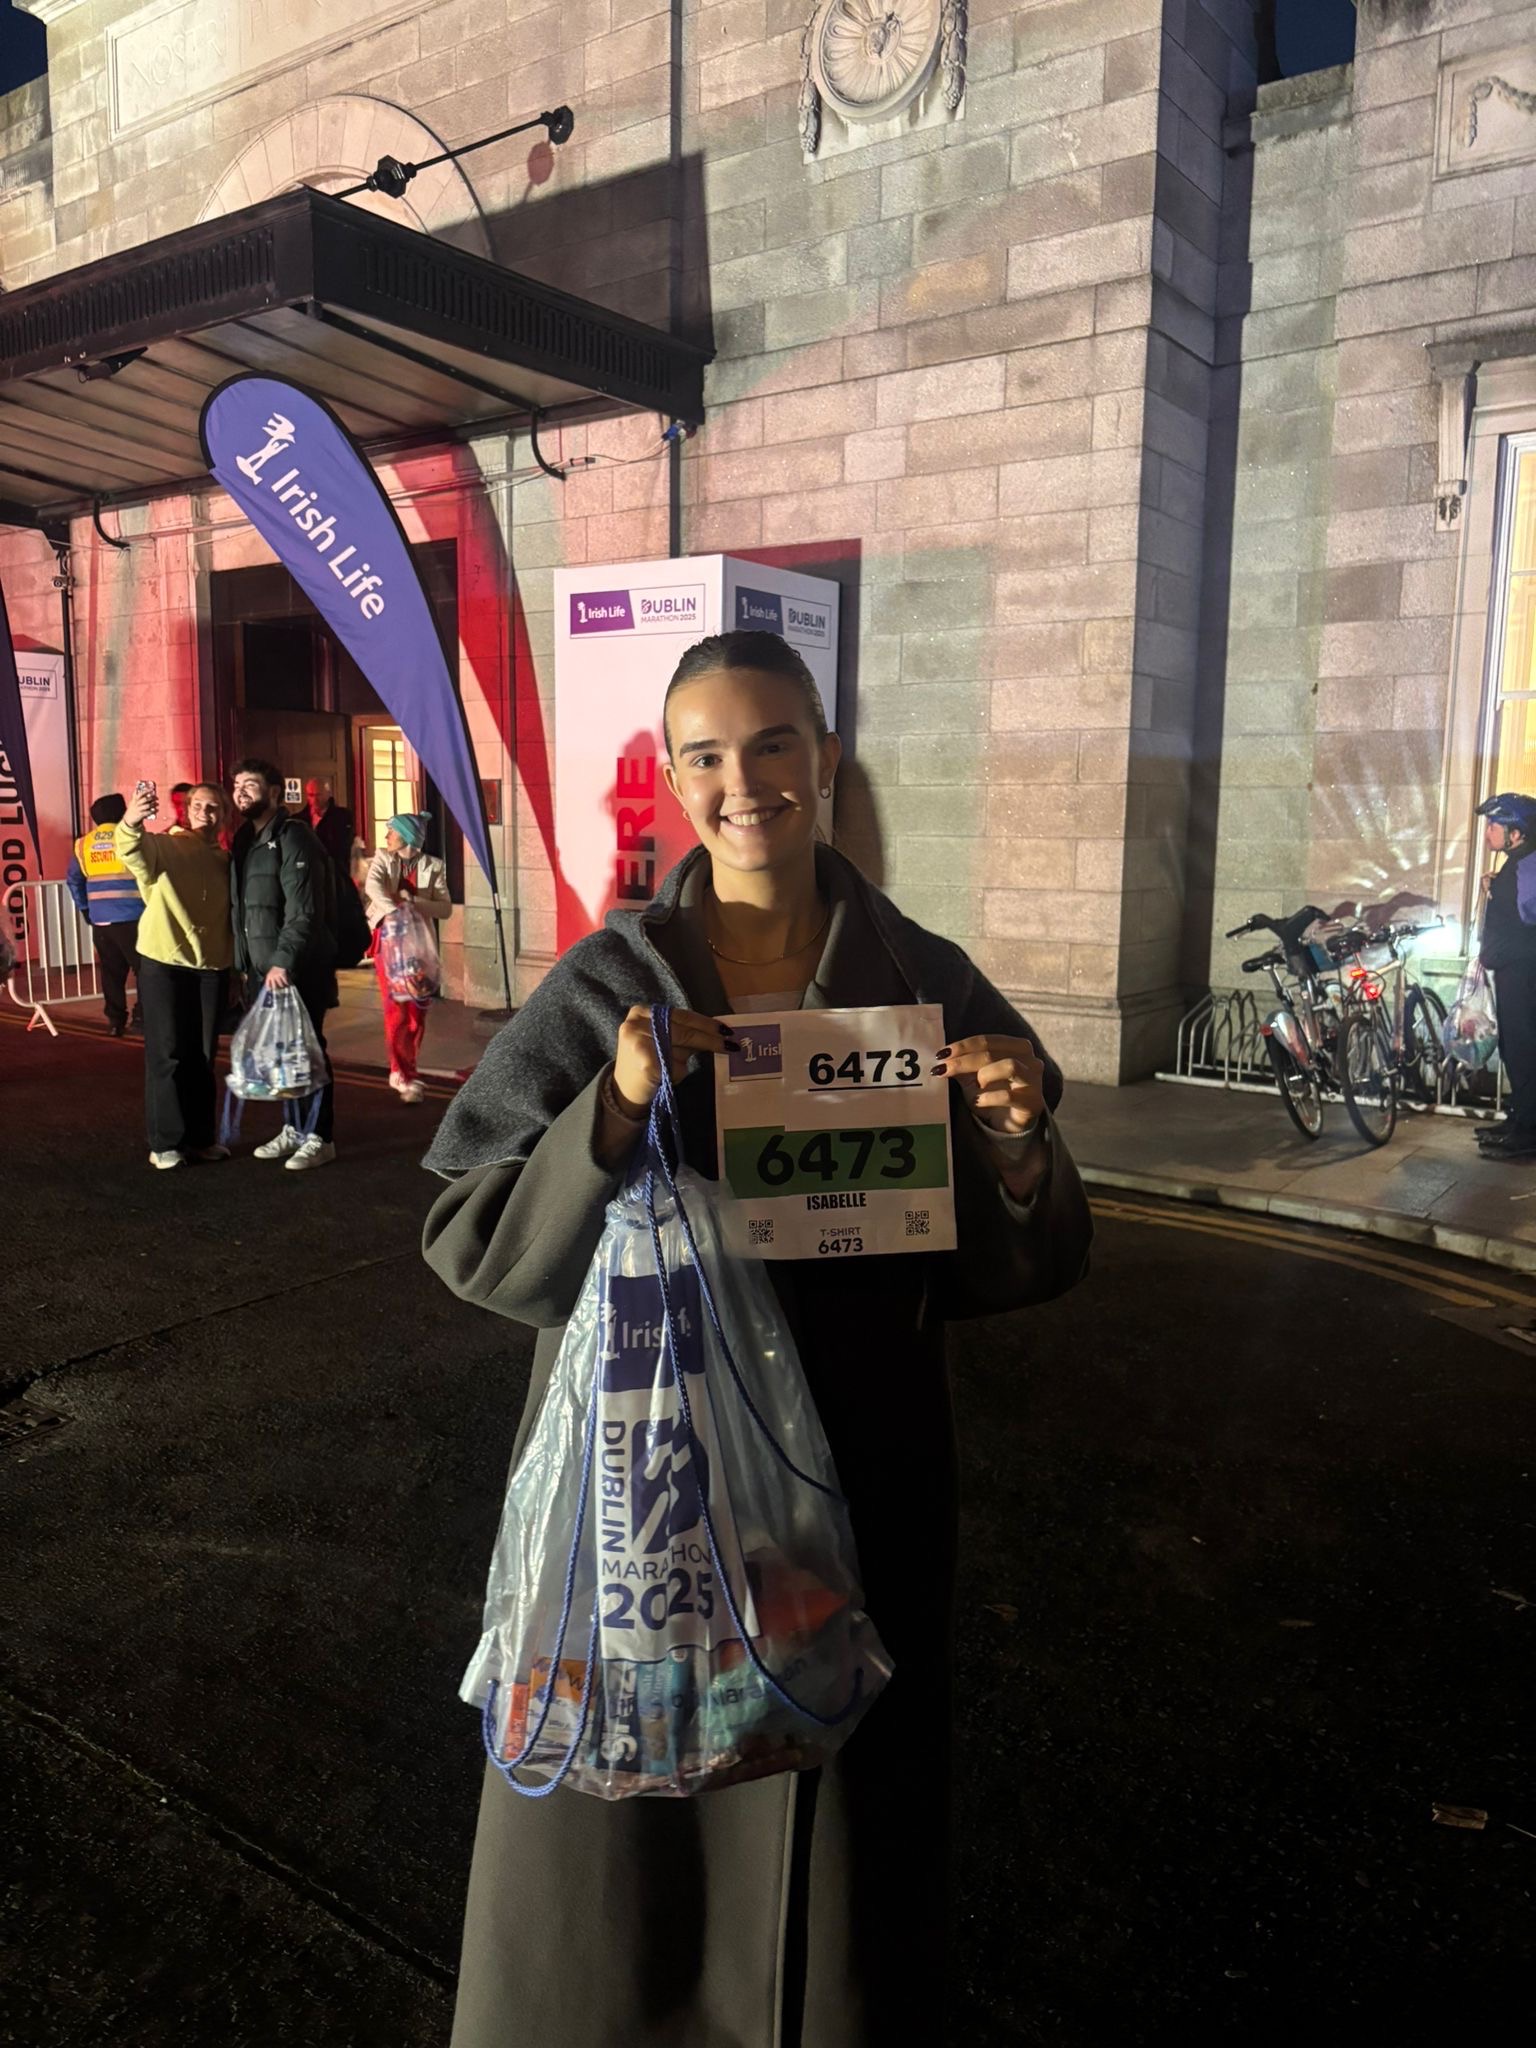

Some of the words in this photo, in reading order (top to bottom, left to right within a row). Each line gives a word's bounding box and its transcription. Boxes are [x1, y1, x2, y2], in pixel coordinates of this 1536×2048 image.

[271, 468, 337, 553] Irish
[328, 545, 385, 620] Life
[588, 607, 607, 619] Irish
[609, 605, 626, 618] Life
[641, 597, 697, 615] DUBLIN
[641, 615, 679, 624] MARATHON
[788, 608, 826, 629] DUBLIN
[19, 676, 51, 686] UBLIN
[0, 744, 24, 825] LUC
[617, 757, 656, 911] ERE
[3, 838, 30, 940] GOOD
[809, 1049, 921, 1085] 6473
[757, 1128, 917, 1186] 6473
[806, 1192, 867, 1210] ISABELLE
[818, 1237, 864, 1255] 6473
[820, 1226, 861, 1237] T-SHIRT
[622, 1320, 668, 1350] Iris
[602, 1420, 627, 1553] DUBLIN
[602, 1567, 715, 1631] 2025
